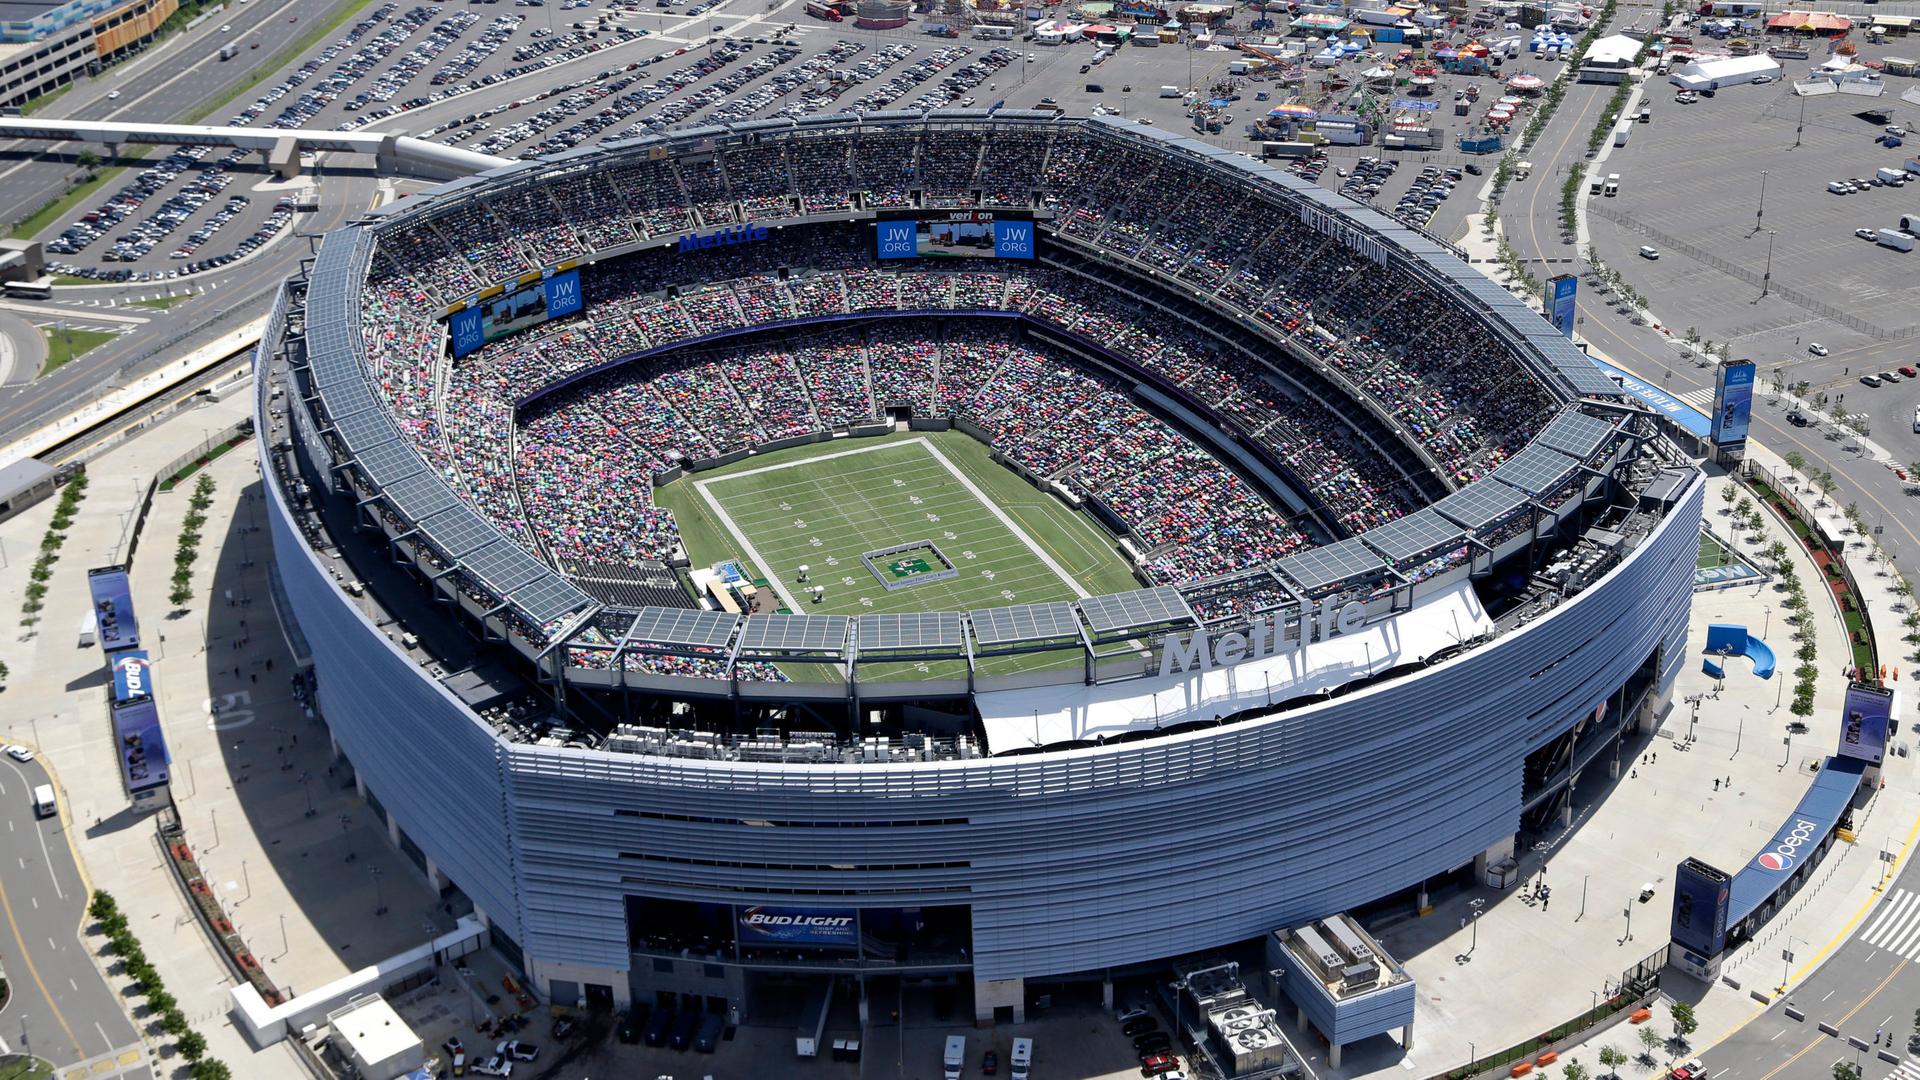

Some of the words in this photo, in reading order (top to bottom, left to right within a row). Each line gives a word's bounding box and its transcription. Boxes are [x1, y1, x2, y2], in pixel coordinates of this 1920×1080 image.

[950, 210, 993, 220] verizon
[679, 222, 769, 253] MetLife
[885, 228, 910, 241] JW
[1001, 228, 1027, 241] JW
[1301, 205, 1343, 243] METLIFE
[1345, 228, 1388, 270] STADIUM
[882, 242, 911, 252] .ORG
[999, 242, 1028, 252] .ORG
[552, 280, 574, 299] JW
[551, 295, 576, 311] .ORG
[458, 315, 477, 337] JW
[1158, 593, 1368, 679] MetLife
[125, 662, 143, 690] BUD
[1777, 819, 1817, 858] pepsi
[750, 914, 793, 926] BUD
[792, 915, 853, 927] LIGHT
